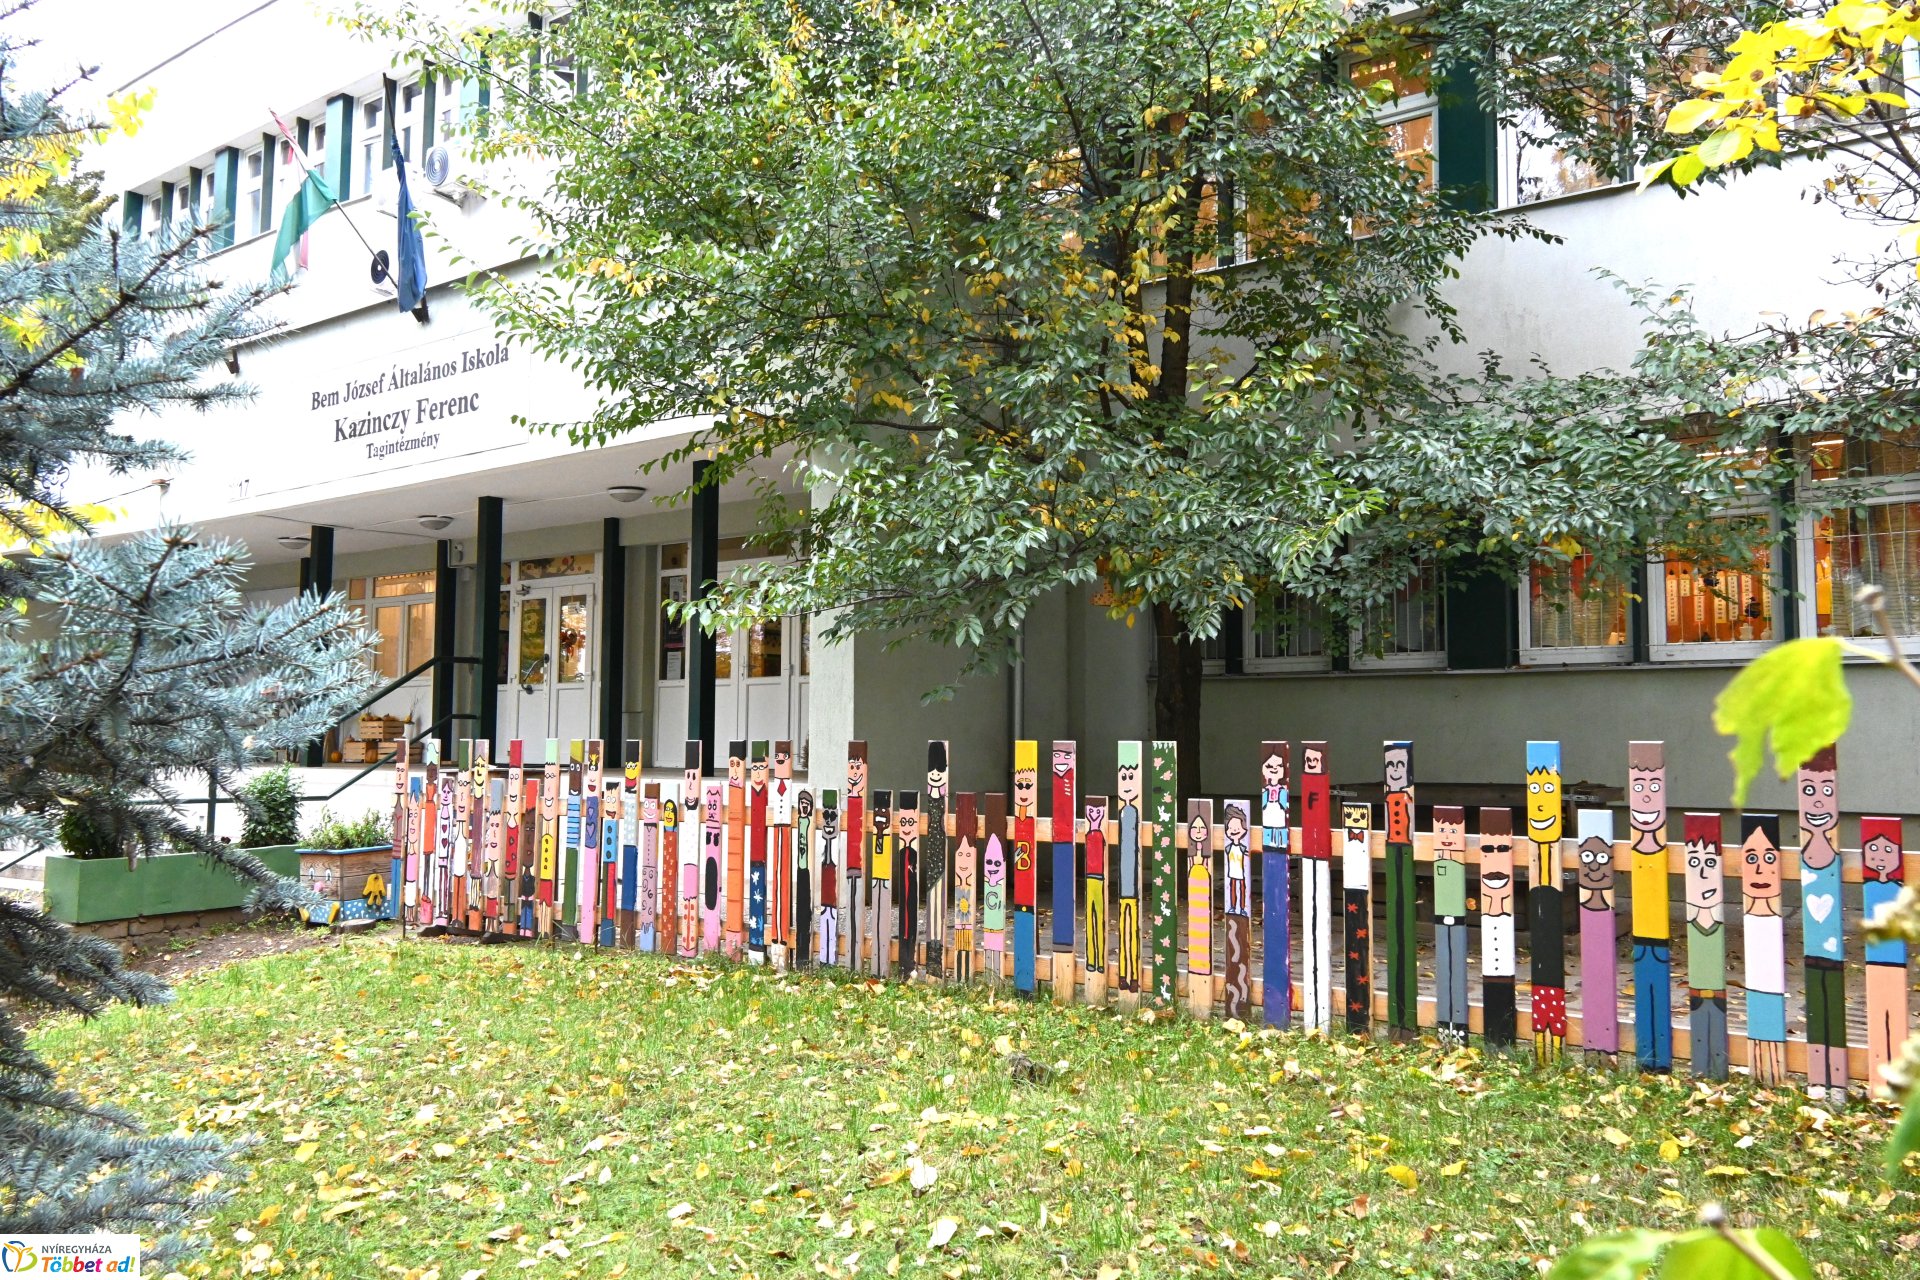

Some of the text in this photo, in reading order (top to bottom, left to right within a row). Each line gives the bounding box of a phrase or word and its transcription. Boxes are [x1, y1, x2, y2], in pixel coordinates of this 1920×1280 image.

[311, 343, 510, 411] Bem József Általános Iskola
[333, 391, 480, 442] Kazinczy Ferenc
[366, 431, 441, 460] Tagintézmény
[1308, 791, 1319, 810] F
[1016, 840, 1031, 870] B
